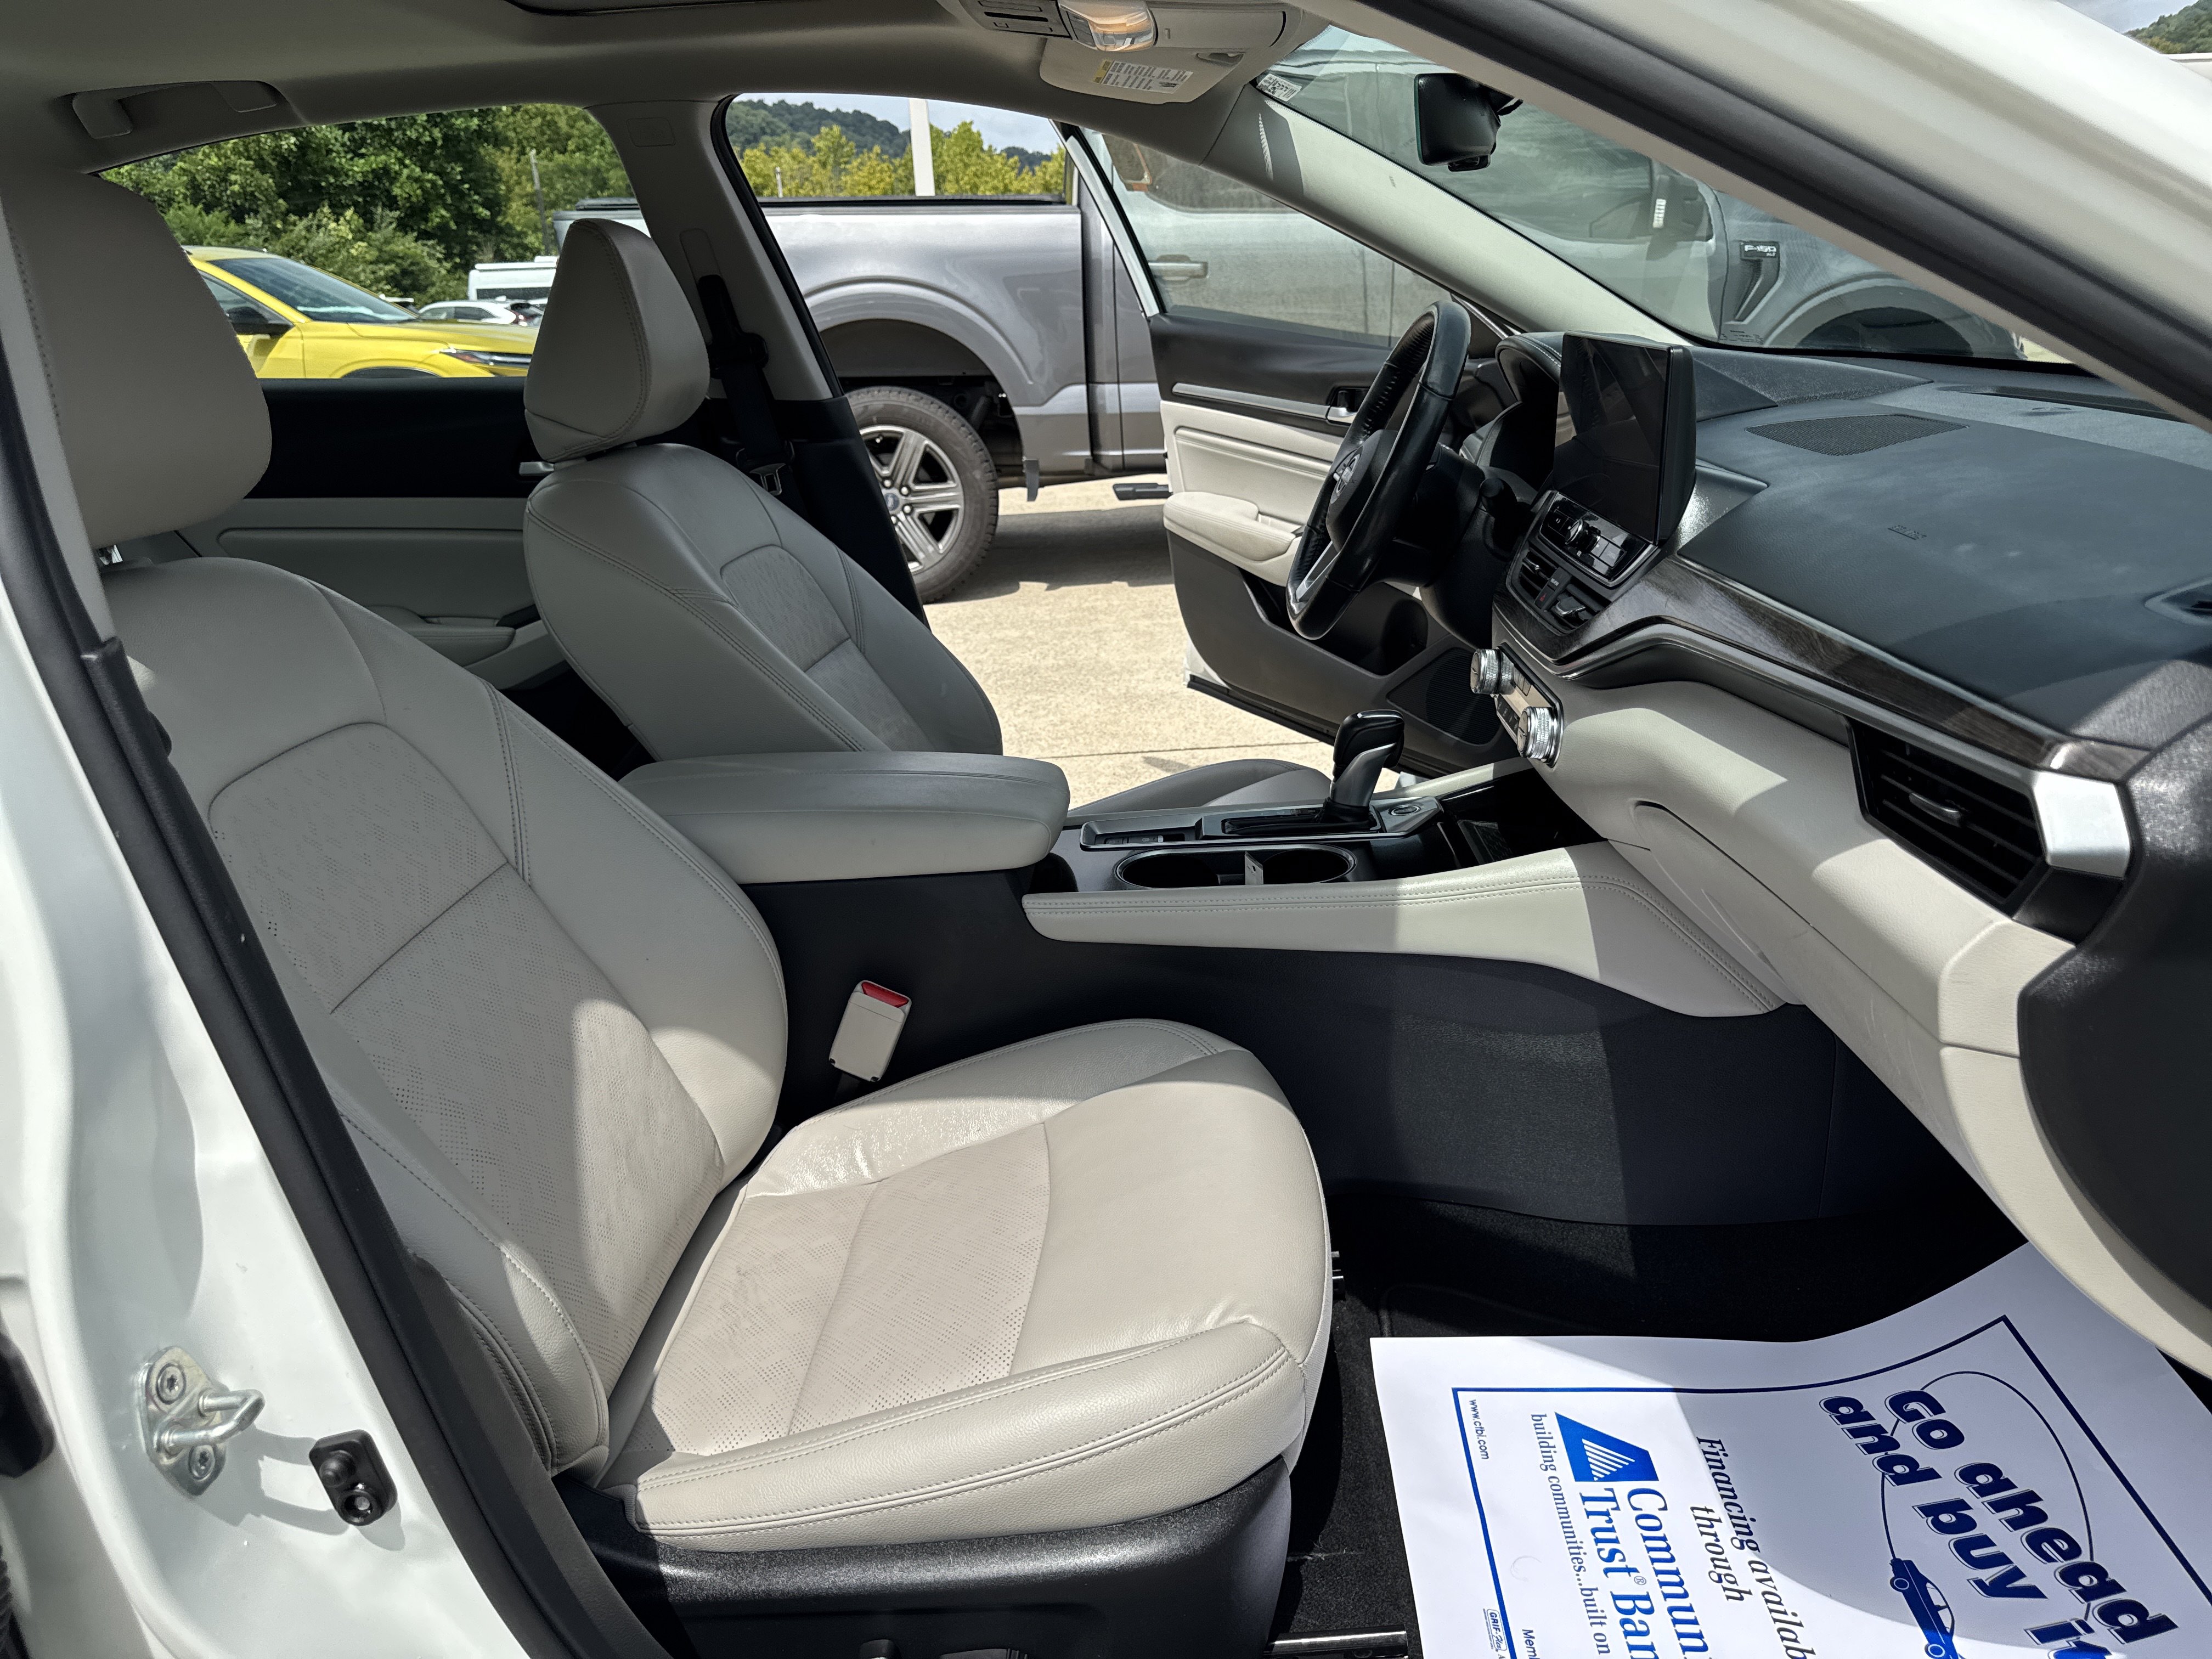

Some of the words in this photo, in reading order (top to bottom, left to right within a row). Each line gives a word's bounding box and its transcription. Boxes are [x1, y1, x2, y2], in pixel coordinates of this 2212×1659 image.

[1469, 1399, 1489, 1459] www.ctbi.com
[1696, 1436, 1760, 1553] Financing
[1819, 1396, 1942, 1487] and
[1912, 1498, 2049, 1600] buy
[1531, 1413, 1556, 1471] building
[1594, 1633, 1611, 1655] on
[1627, 1487, 1712, 1659] Commun
[1690, 1505, 1753, 1602] through
[1884, 1389, 1965, 1450] Go
[1954, 1462, 2179, 1645] ahead
[1521, 1629, 1541, 1659] Mem
